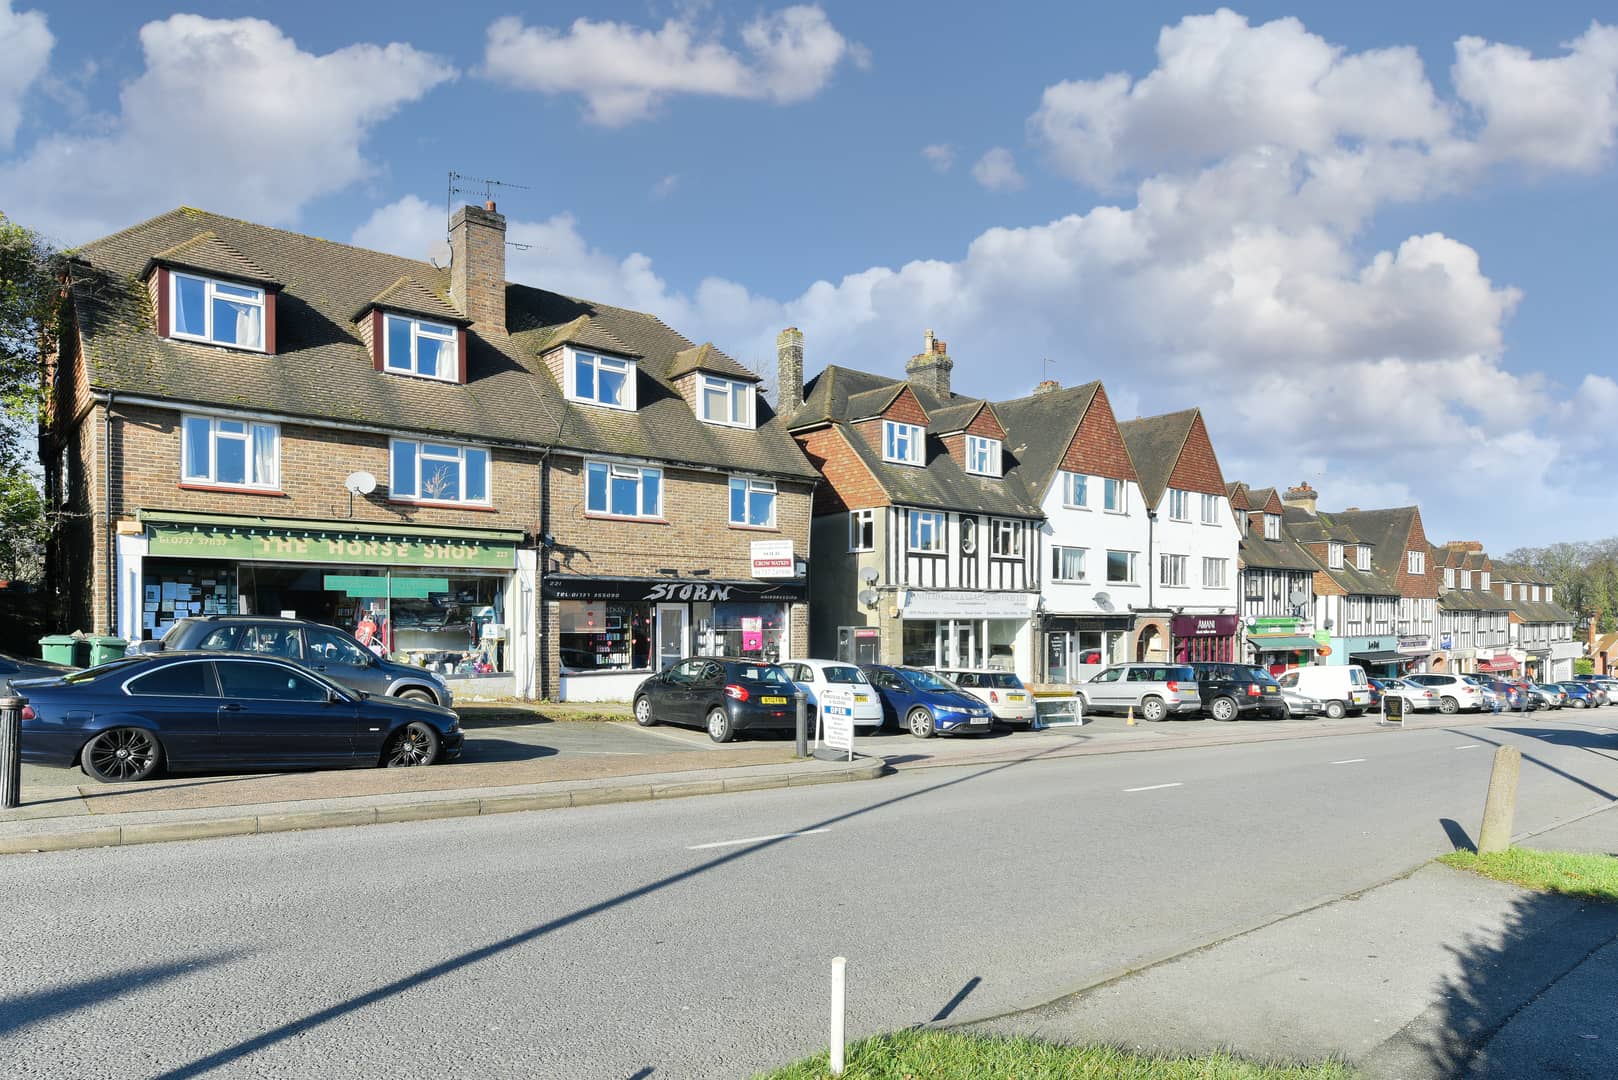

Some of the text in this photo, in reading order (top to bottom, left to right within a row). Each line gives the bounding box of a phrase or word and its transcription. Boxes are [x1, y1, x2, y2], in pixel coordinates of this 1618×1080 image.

[260, 538, 480, 560] THE HORSE SHOP
[642, 583, 732, 601] STORM
